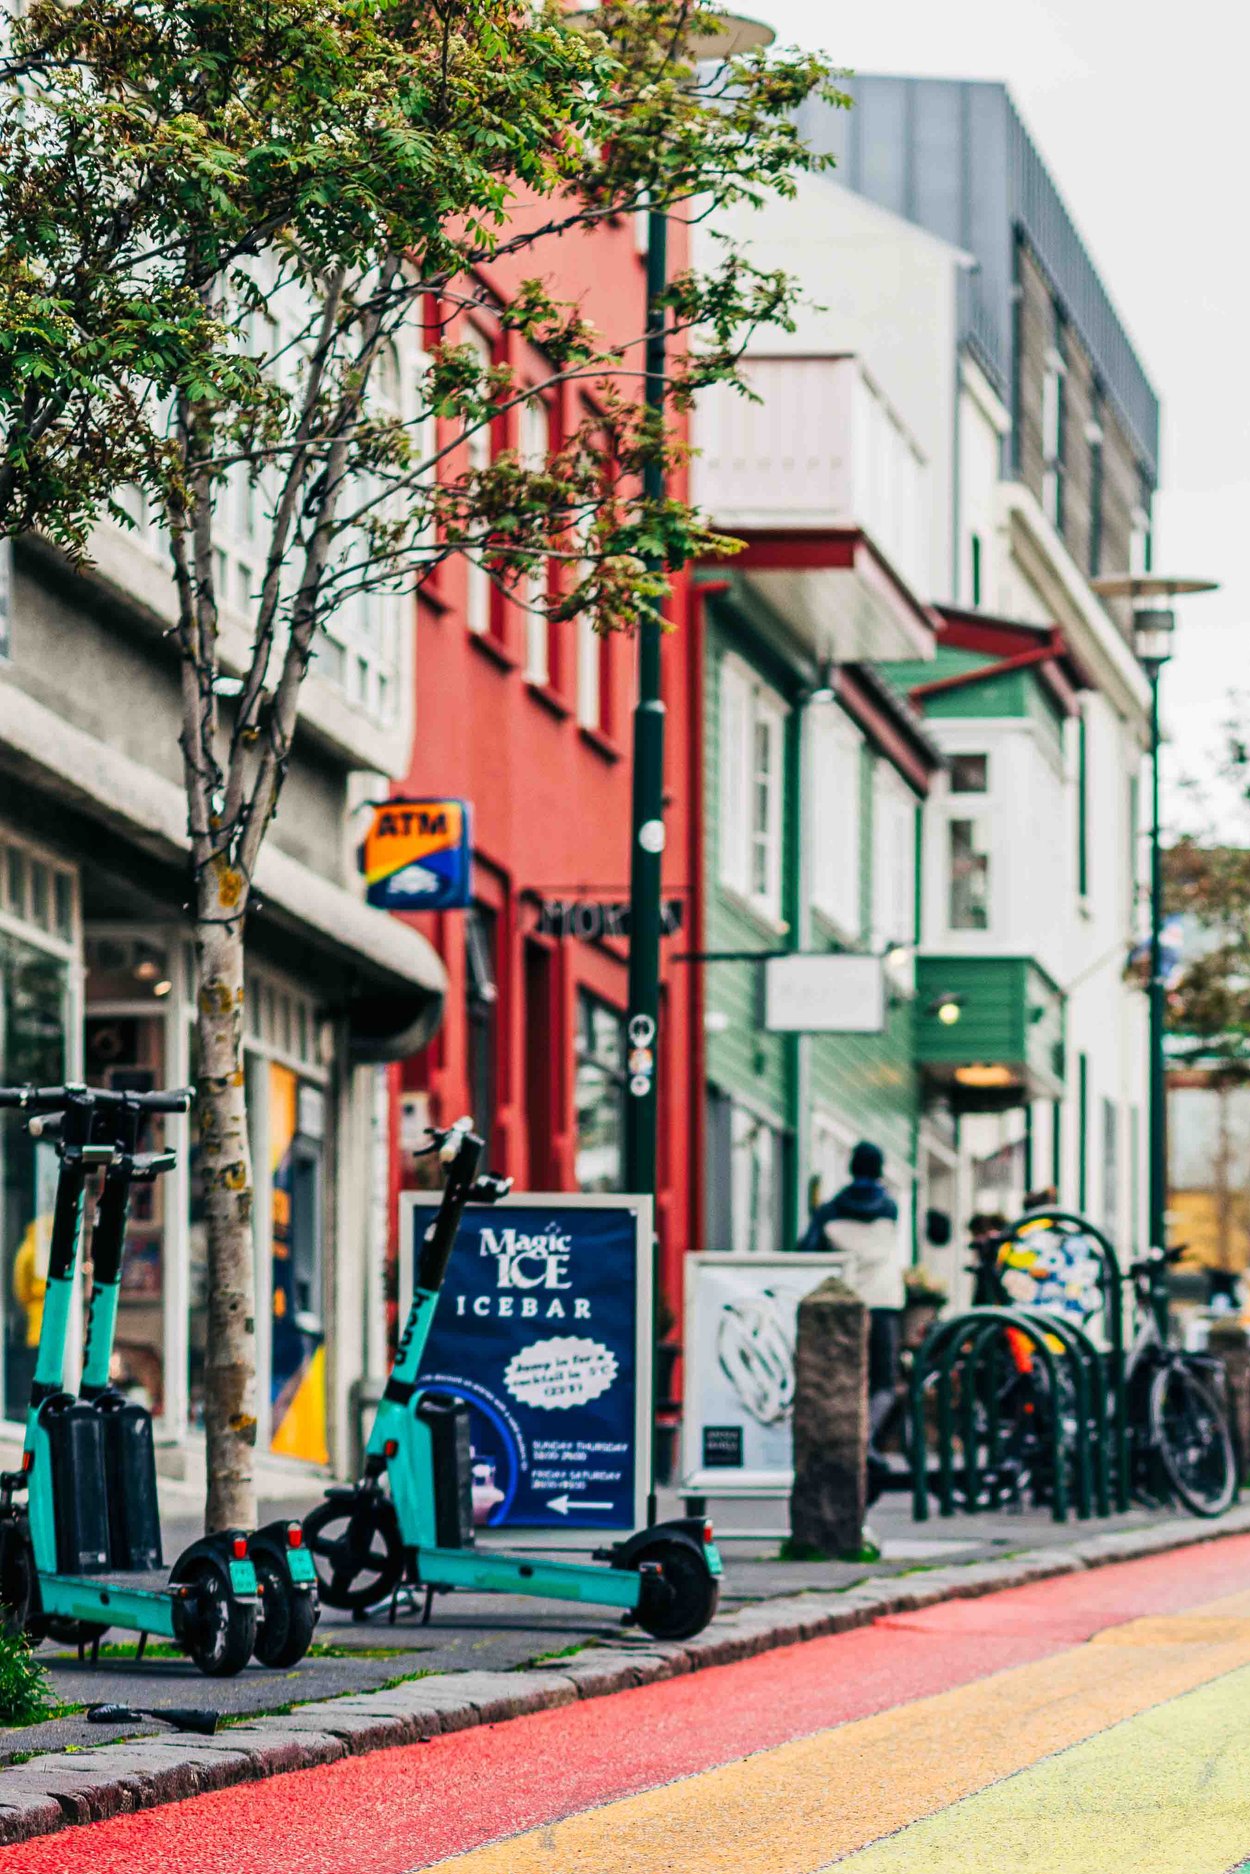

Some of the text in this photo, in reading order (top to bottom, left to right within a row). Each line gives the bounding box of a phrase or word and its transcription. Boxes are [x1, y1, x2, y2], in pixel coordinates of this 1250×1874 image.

[377, 811, 447, 837] ATM
[479, 1228, 573, 1260] Magic
[496, 1253, 573, 1290] ICE
[456, 1295, 592, 1319] ICEBAR
[533, 1440, 628, 1452] SUNDAY THURSDAY
[569, 1471, 621, 1480] SATURDAY
